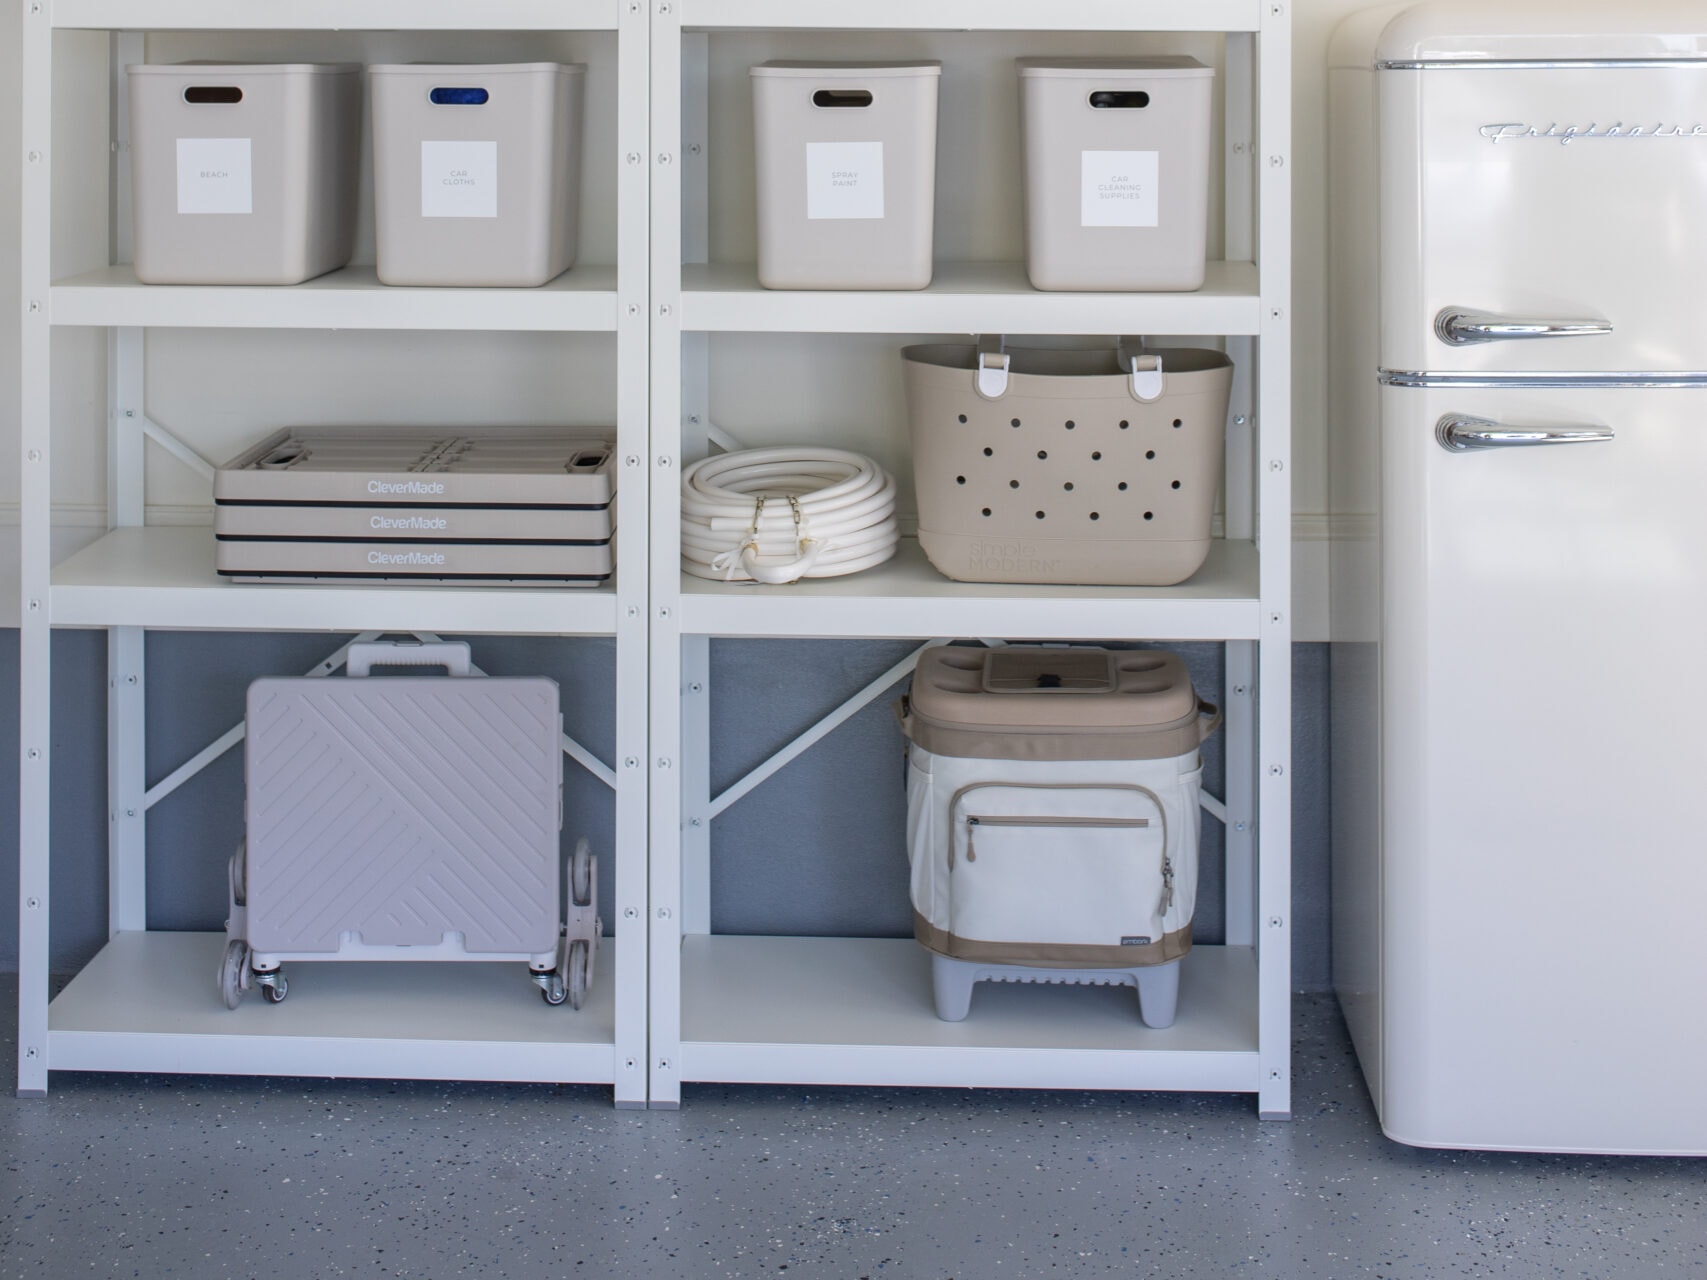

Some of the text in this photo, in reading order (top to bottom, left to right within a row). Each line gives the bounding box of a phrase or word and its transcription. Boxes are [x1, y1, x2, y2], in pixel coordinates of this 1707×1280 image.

[1478, 121, 1707, 145] Frigidaire
[442, 178, 476, 186] CLOTHS
[1111, 175, 1129, 183] CAR
[1099, 192, 1141, 200] SUPPLIES
[367, 480, 445, 495] CleverMade
[369, 515, 447, 530] CleverMade
[968, 539, 1037, 558] simple
[367, 550, 446, 566] CleverMade
